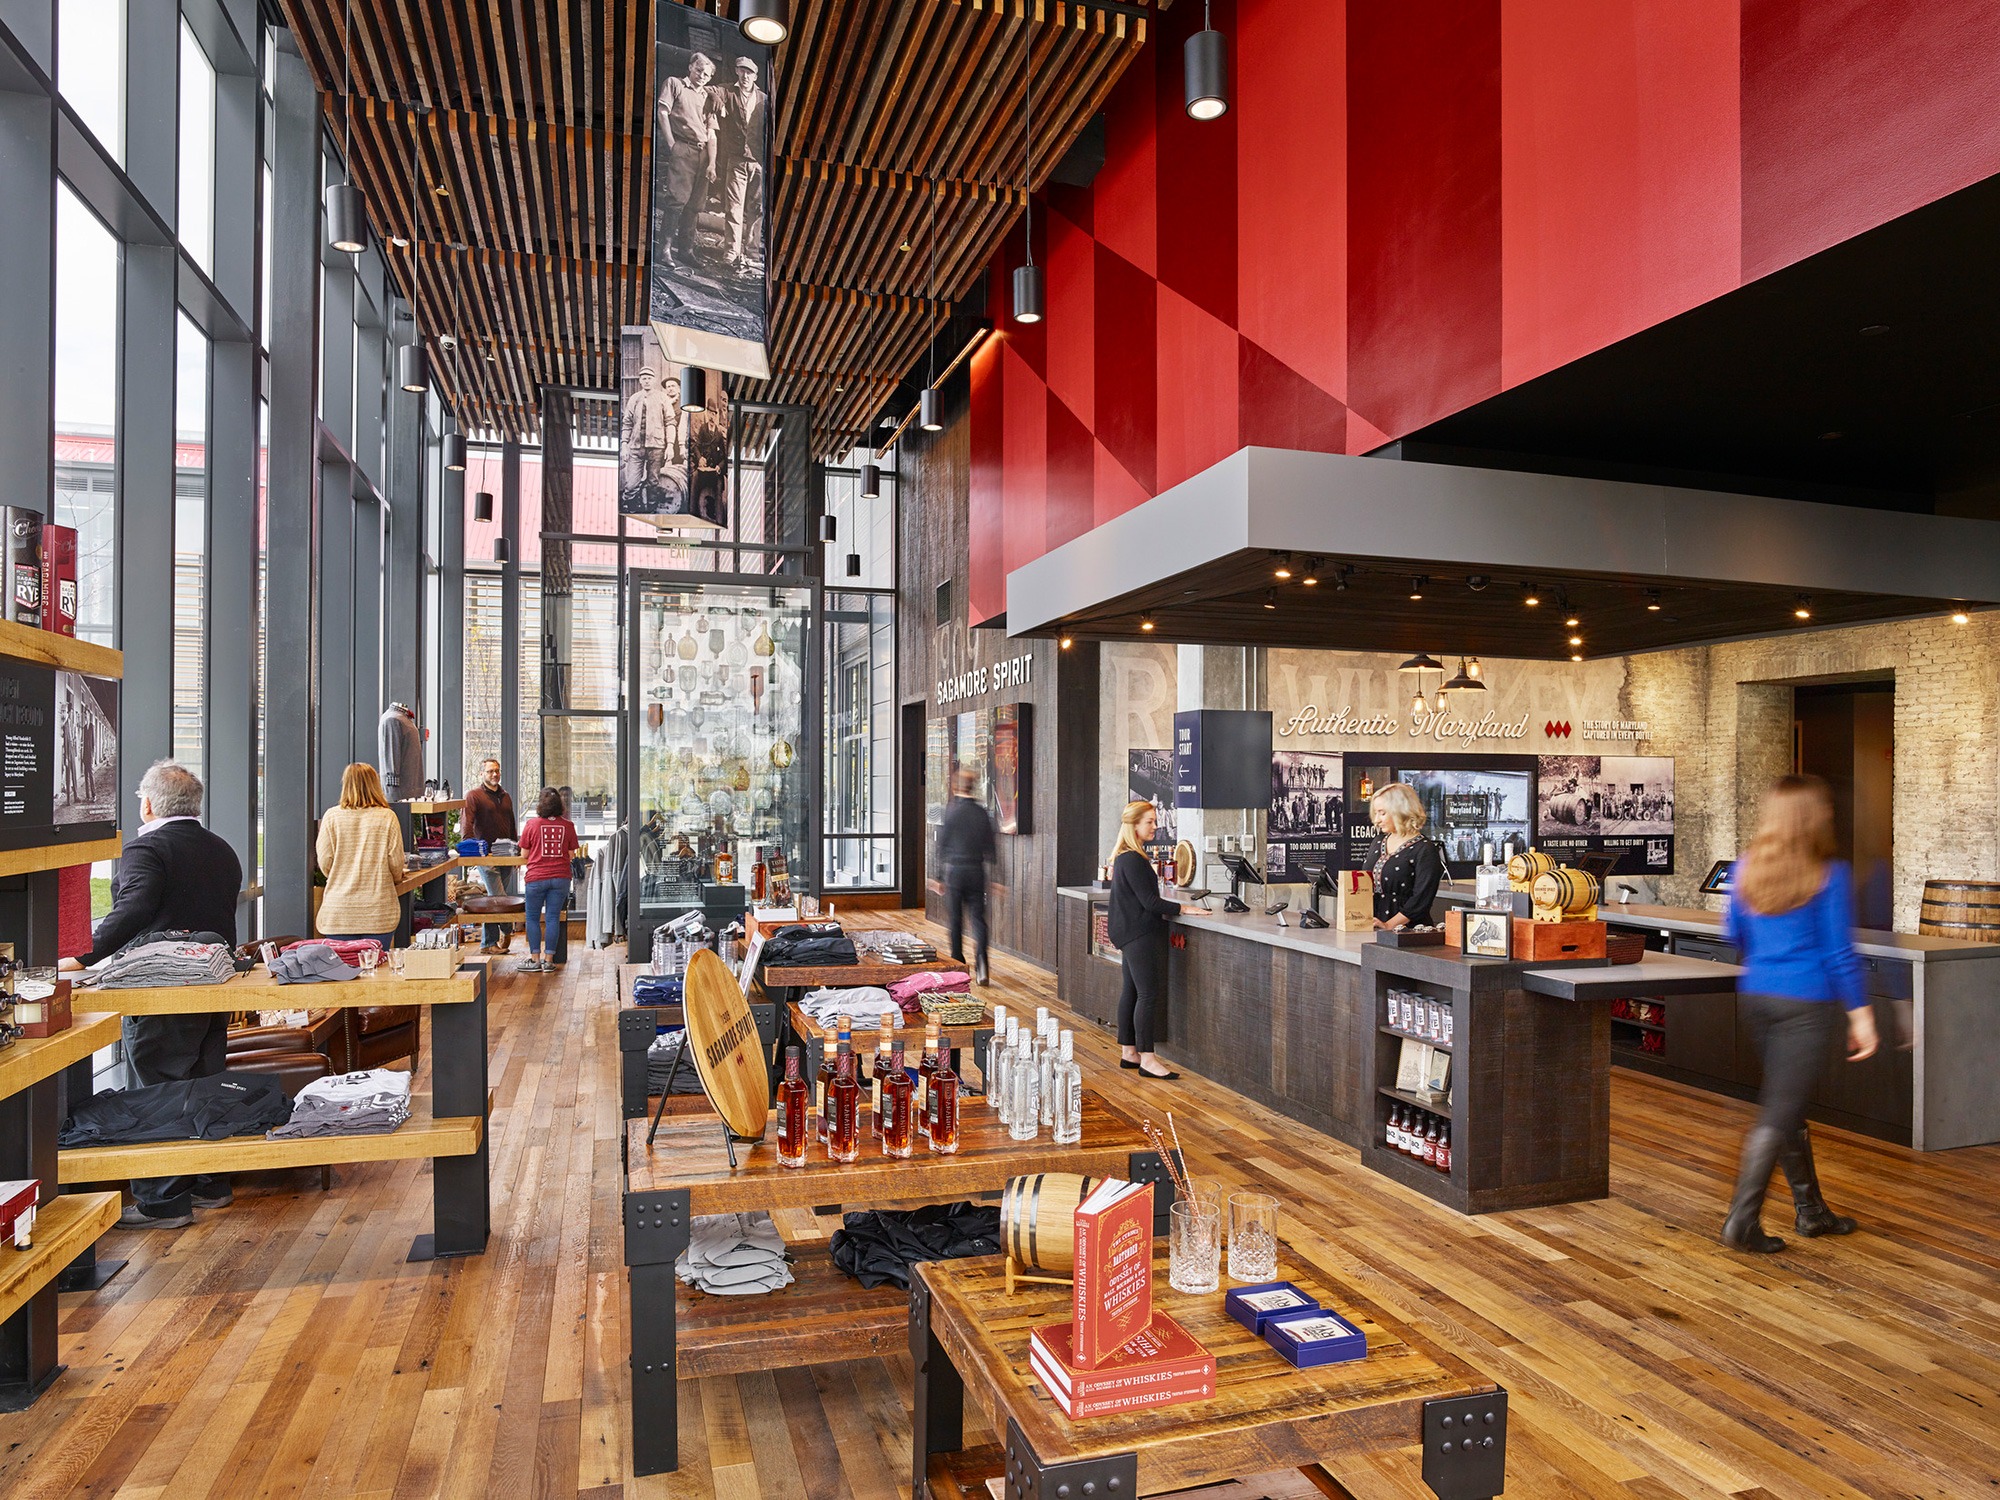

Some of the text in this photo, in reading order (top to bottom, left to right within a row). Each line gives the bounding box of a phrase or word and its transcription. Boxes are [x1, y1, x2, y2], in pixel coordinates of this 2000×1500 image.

[16, 584, 39, 603] RYE
[937, 653, 1033, 706] SAGAMORE SPIRIT
[1279, 704, 1530, 749] Authentic Maryland
[1583, 720, 1648, 730] THE STORY OF MARYLAND
[1178, 728, 1191, 742] TOUR
[1583, 731, 1653, 741] CAPTURED IN EVERY BOTTLE
[1178, 742, 1193, 756] START
[1450, 806, 1482, 815] Maryland Rye
[1350, 825, 1380, 839] LEGACY
[1290, 842, 1337, 850] TOO GOOD TO IGNORE
[706, 1011, 755, 1069] SAGAMORE SPIRIT
[1109, 1260, 1141, 1287] ODYSSEY OF
[1078, 1268, 1087, 1321] WHISKIES
[1103, 1275, 1146, 1312] WHISKIES
[1093, 1380, 1115, 1388] ODYSSEY
[1123, 1371, 1173, 1387] WHISKIES
[1092, 1400, 1114, 1408] ODYSSEY
[1122, 1390, 1172, 1407] WHISKIES
